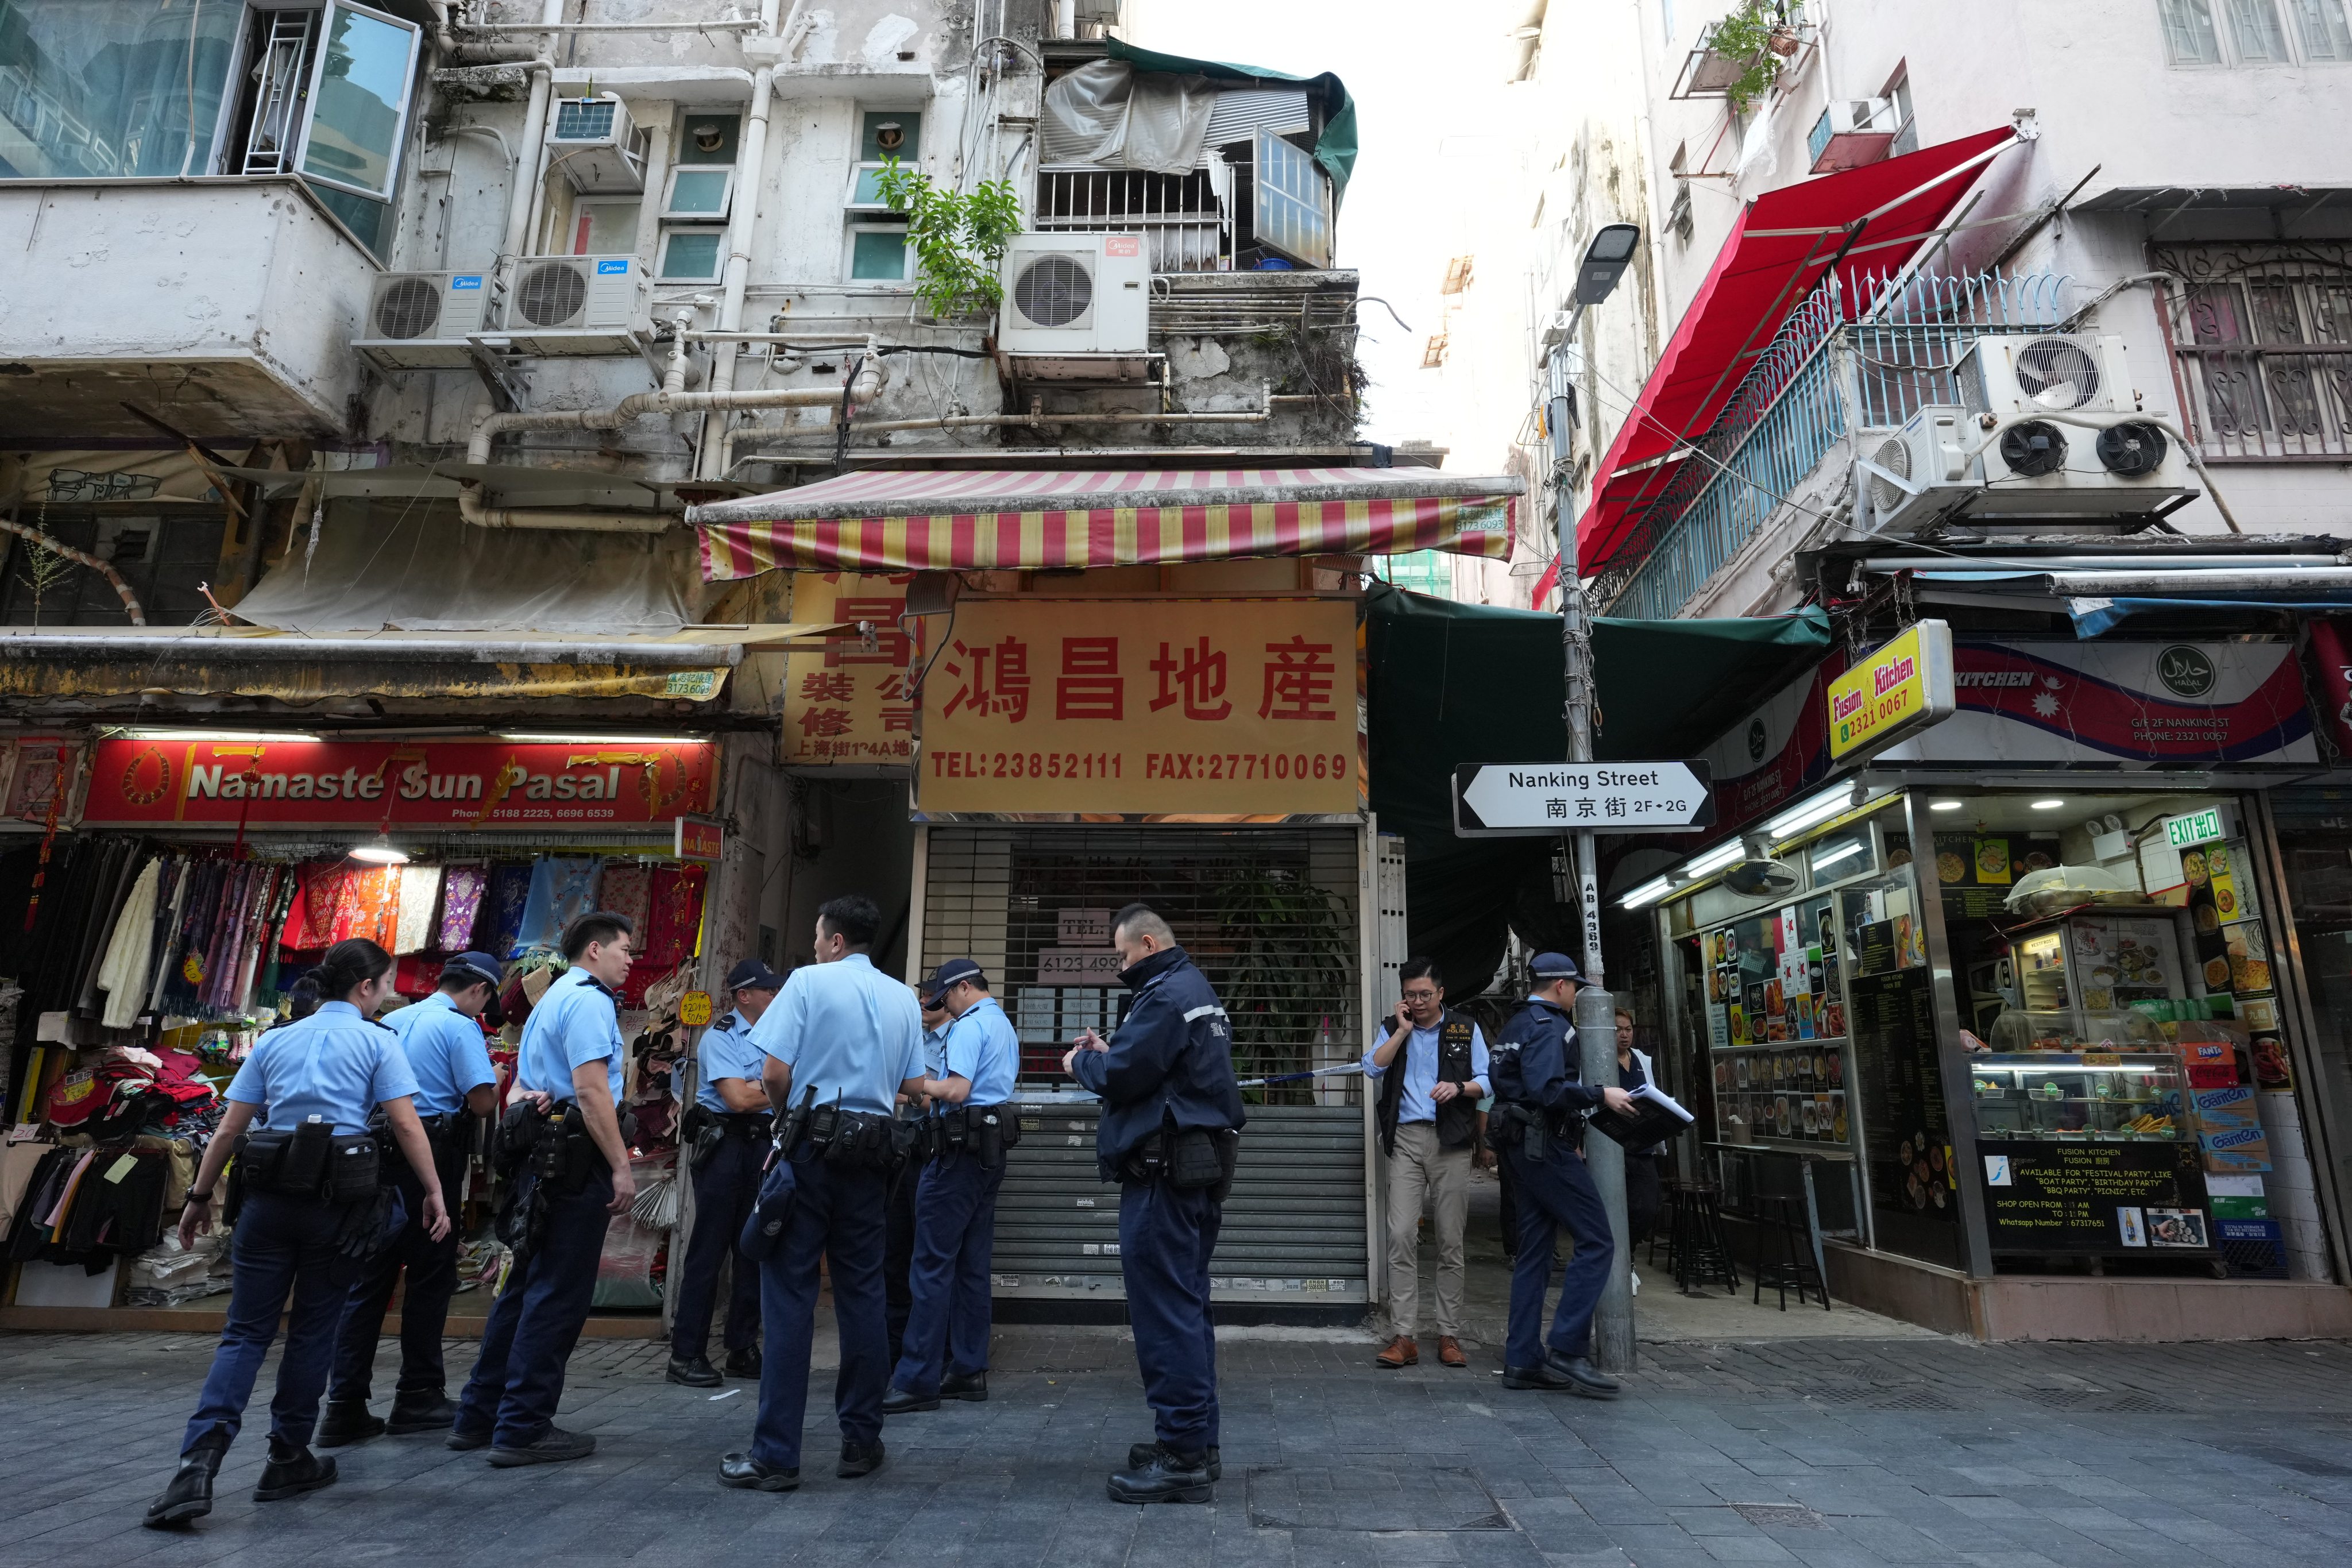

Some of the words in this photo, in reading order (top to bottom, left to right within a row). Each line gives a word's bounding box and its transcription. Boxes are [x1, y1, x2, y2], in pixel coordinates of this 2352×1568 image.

[1111, 241, 1136, 249] Midea
[603, 264, 625, 272] Midea
[1906, 415, 1922, 434] Panasonic
[1457, 521, 1479, 530] 3173
[1480, 520, 1503, 528] 6093
[667, 683, 689, 693] 3173
[1833, 689, 1863, 723] Fusion
[1874, 657, 1914, 697] Kitchen
[1850, 709, 1876, 737] 2321
[1879, 689, 1907, 719] 0067
[2131, 717, 2149, 728] G/F
[2152, 717, 2163, 727] 2F
[2165, 717, 2216, 727] NANKING
[2218, 717, 2230, 727] ST
[2134, 732, 2173, 741] PHONE:
[2175, 732, 2200, 741] 2321
[2203, 732, 2227, 741] 0067
[931, 751, 1122, 778] TEL:23852111
[1146, 753, 1347, 781] FAX:27710069
[188, 764, 384, 800] Namaste
[400, 766, 484, 801] Sun
[501, 766, 620, 800] Pasal
[1509, 771, 1589, 789] Nanking
[1597, 770, 1659, 786] Street
[493, 809, 520, 818] 5188
[523, 809, 553, 819] 2225,
[557, 809, 584, 818] 6696
[587, 809, 614, 818] 6539
[1546, 796, 1627, 818] 南京街
[1666, 800, 1686, 812] 2G
[2168, 817, 2196, 846] EXIT
[2195, 810, 2219, 840] 出口
[1063, 919, 1104, 934] TEL:
[1043, 957, 1083, 972] 6123
[2197, 1045, 2223, 1056] FANTA
[13, 1129, 34, 1138] 20
[2212, 1129, 2262, 1149] Ganten
[1999, 1219, 2033, 1227] Whatsapp
